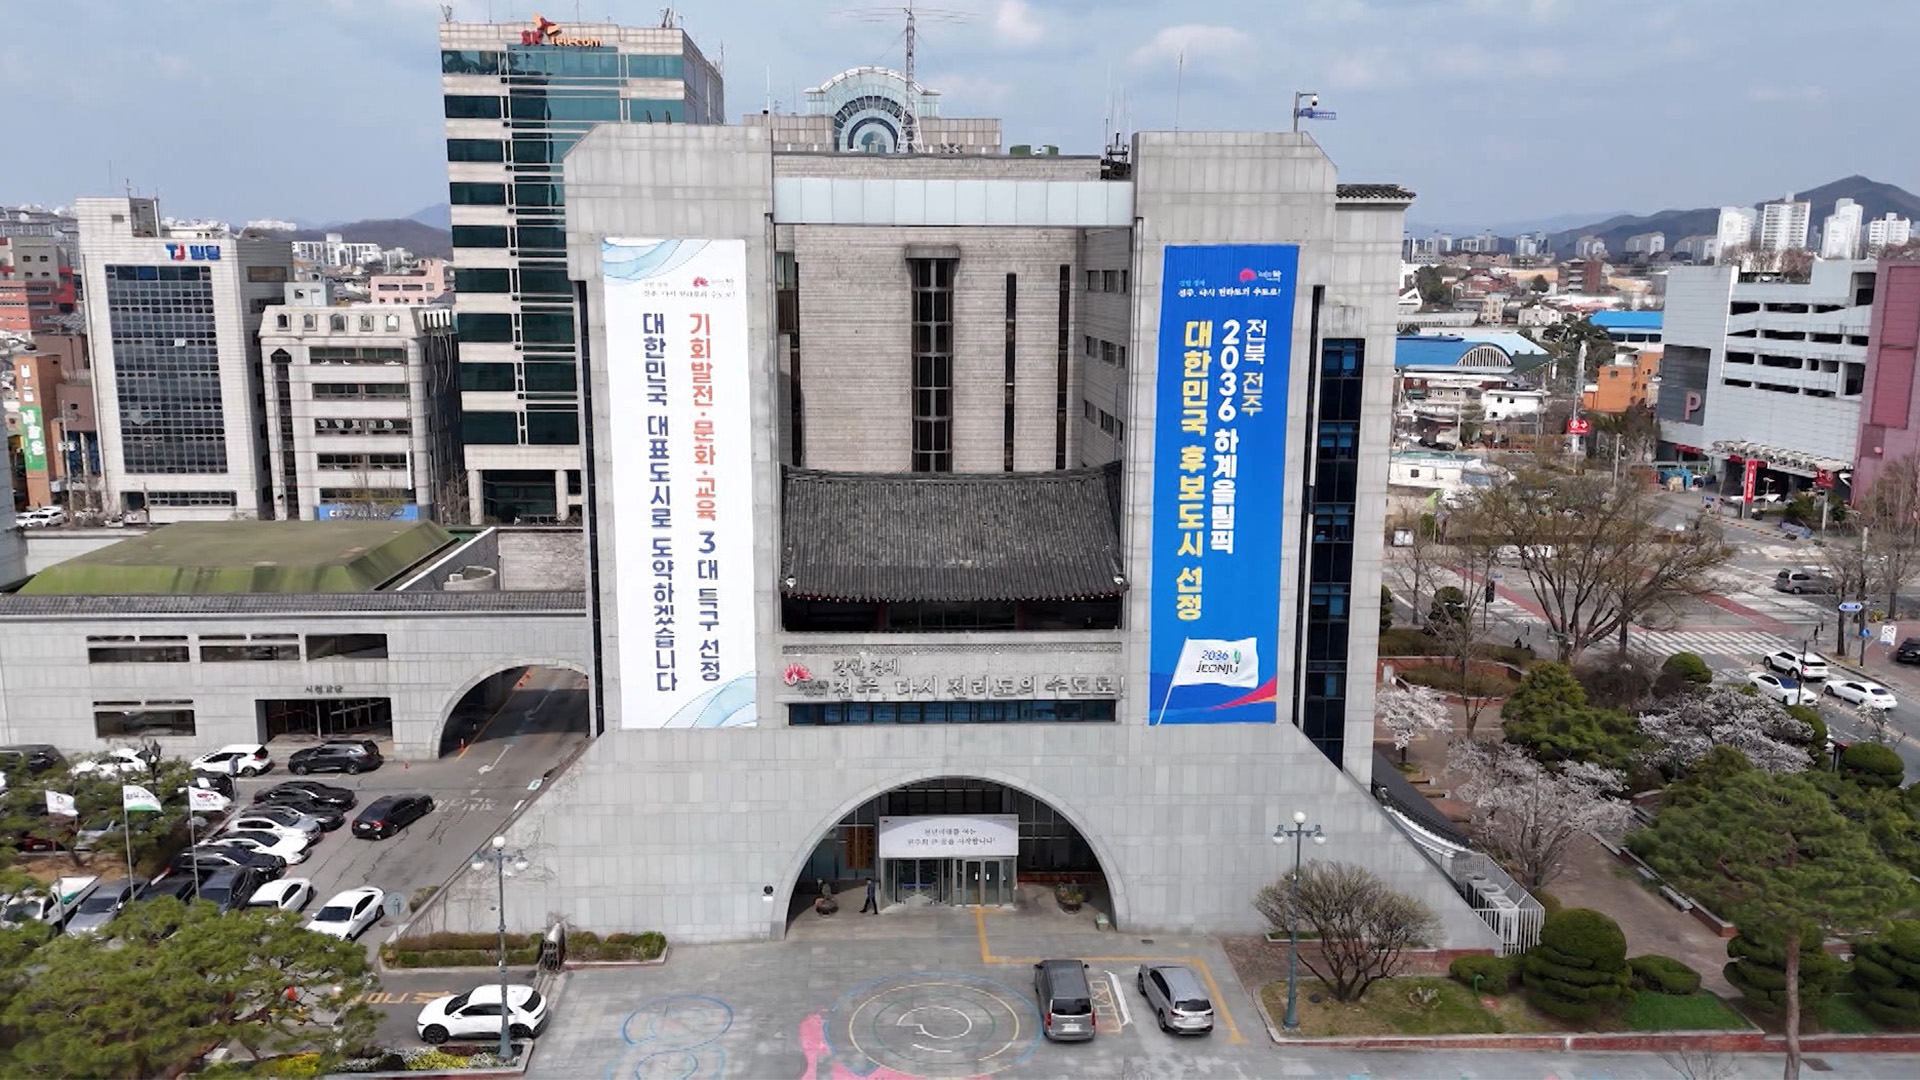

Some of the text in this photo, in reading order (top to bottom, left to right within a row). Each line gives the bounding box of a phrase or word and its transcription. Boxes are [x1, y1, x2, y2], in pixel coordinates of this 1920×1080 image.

[521, 29, 543, 45] SK
[165, 243, 185, 261] TJ
[643, 313, 668, 406] 대한민국
[1241, 319, 1267, 417] 전북 전주
[1685, 391, 1702, 421] P
[1210, 319, 1241, 554] 2036 하계올림픽
[648, 415, 672, 529] 대표도시로
[1176, 319, 1212, 621] 대한민국 후보도시 선정
[652, 537, 678, 691] 도약하겠습니다
[698, 588, 720, 631] 특구
[699, 639, 720, 681] 선정
[1201, 649, 1229, 661] 2036
[895, 675, 938, 699] 다시
[947, 675, 1038, 699] 전라도의
[1045, 675, 1125, 699] 수도로!
